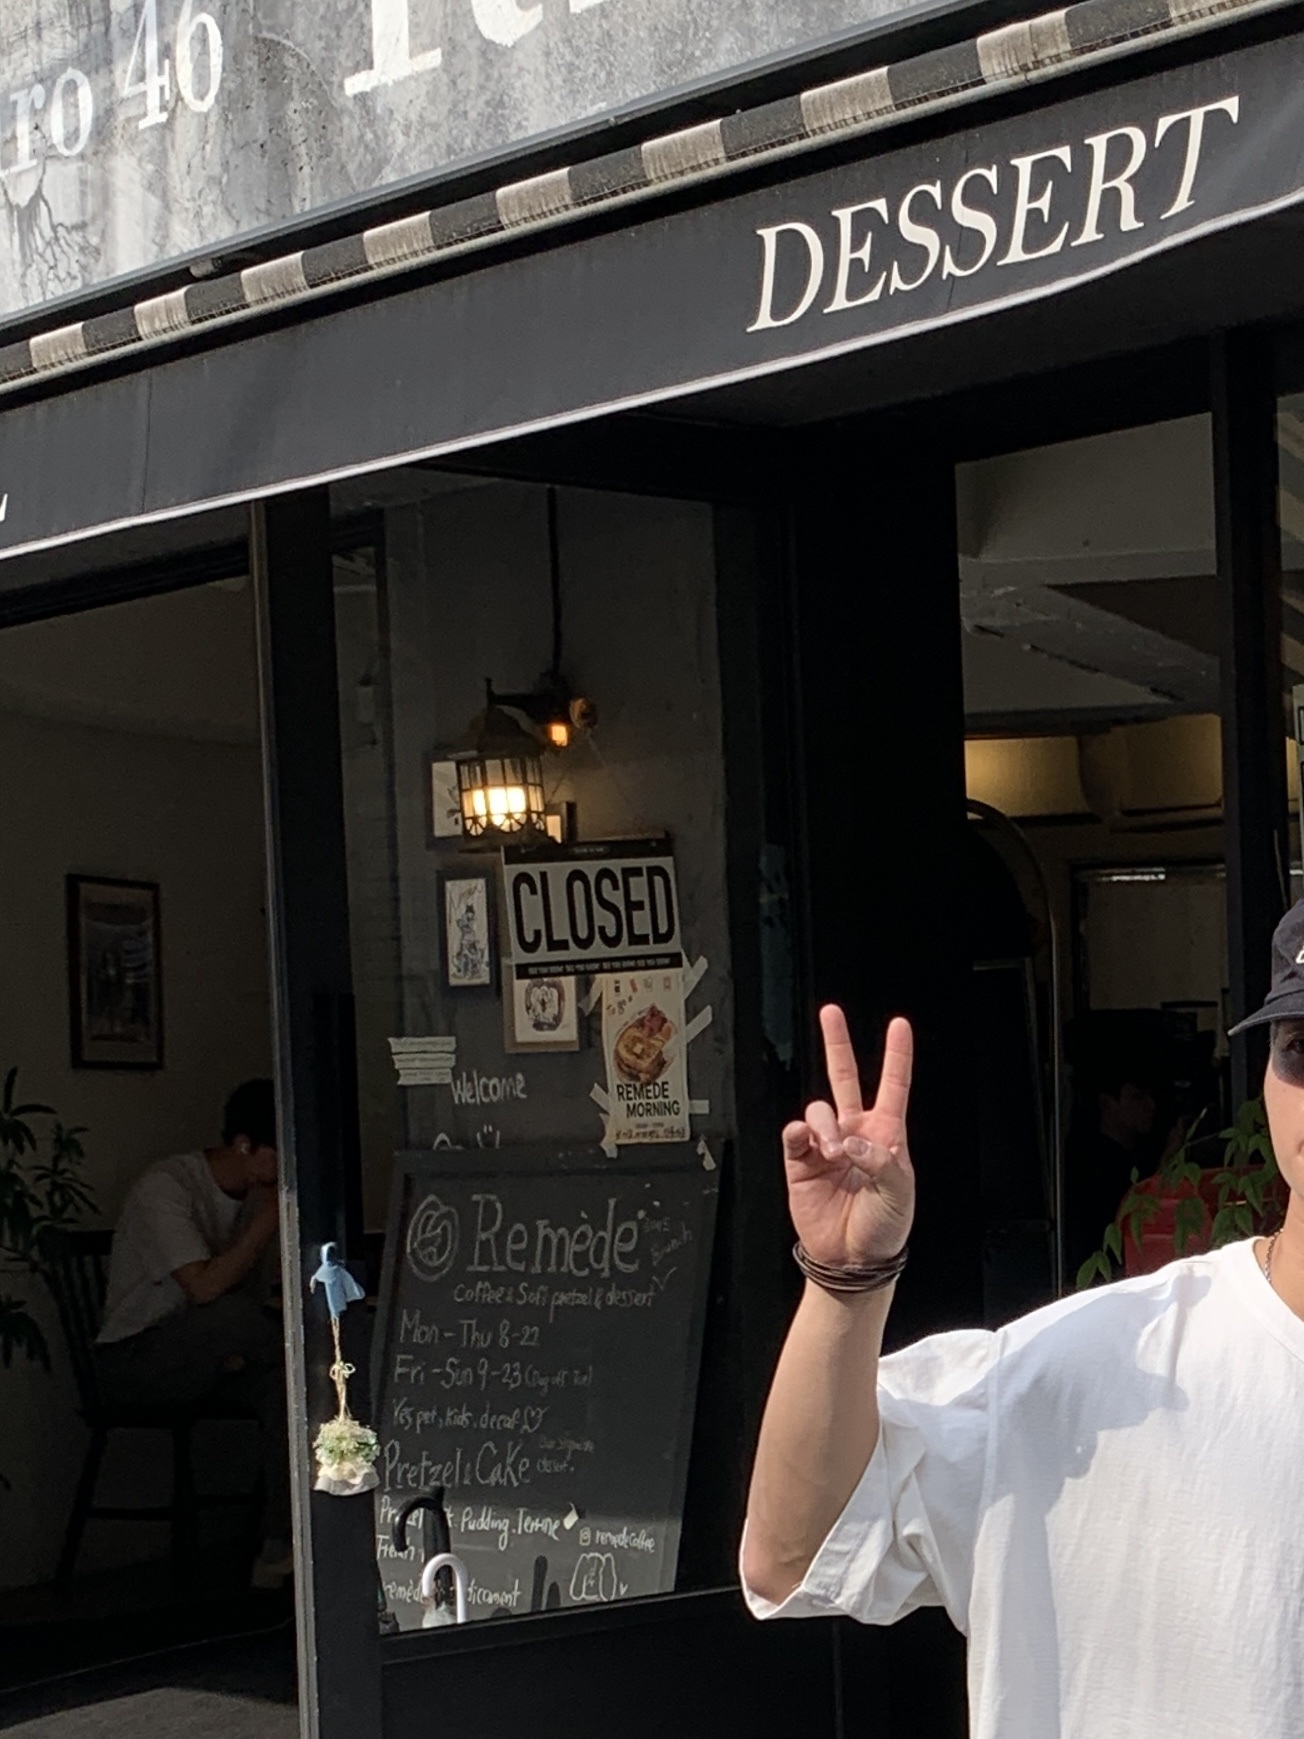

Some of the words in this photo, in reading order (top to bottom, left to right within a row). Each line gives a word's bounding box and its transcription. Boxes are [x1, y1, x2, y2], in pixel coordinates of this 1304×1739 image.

[746, 95, 1241, 333] DESSERT
[512, 865, 676, 954] CLOSED
[450, 1069, 528, 1106] Welcome
[616, 1081, 670, 1102] REMEDE
[626, 1100, 680, 1119] MORNING
[465, 1194, 640, 1279] Remède
[453, 1280, 504, 1303] Coffee
